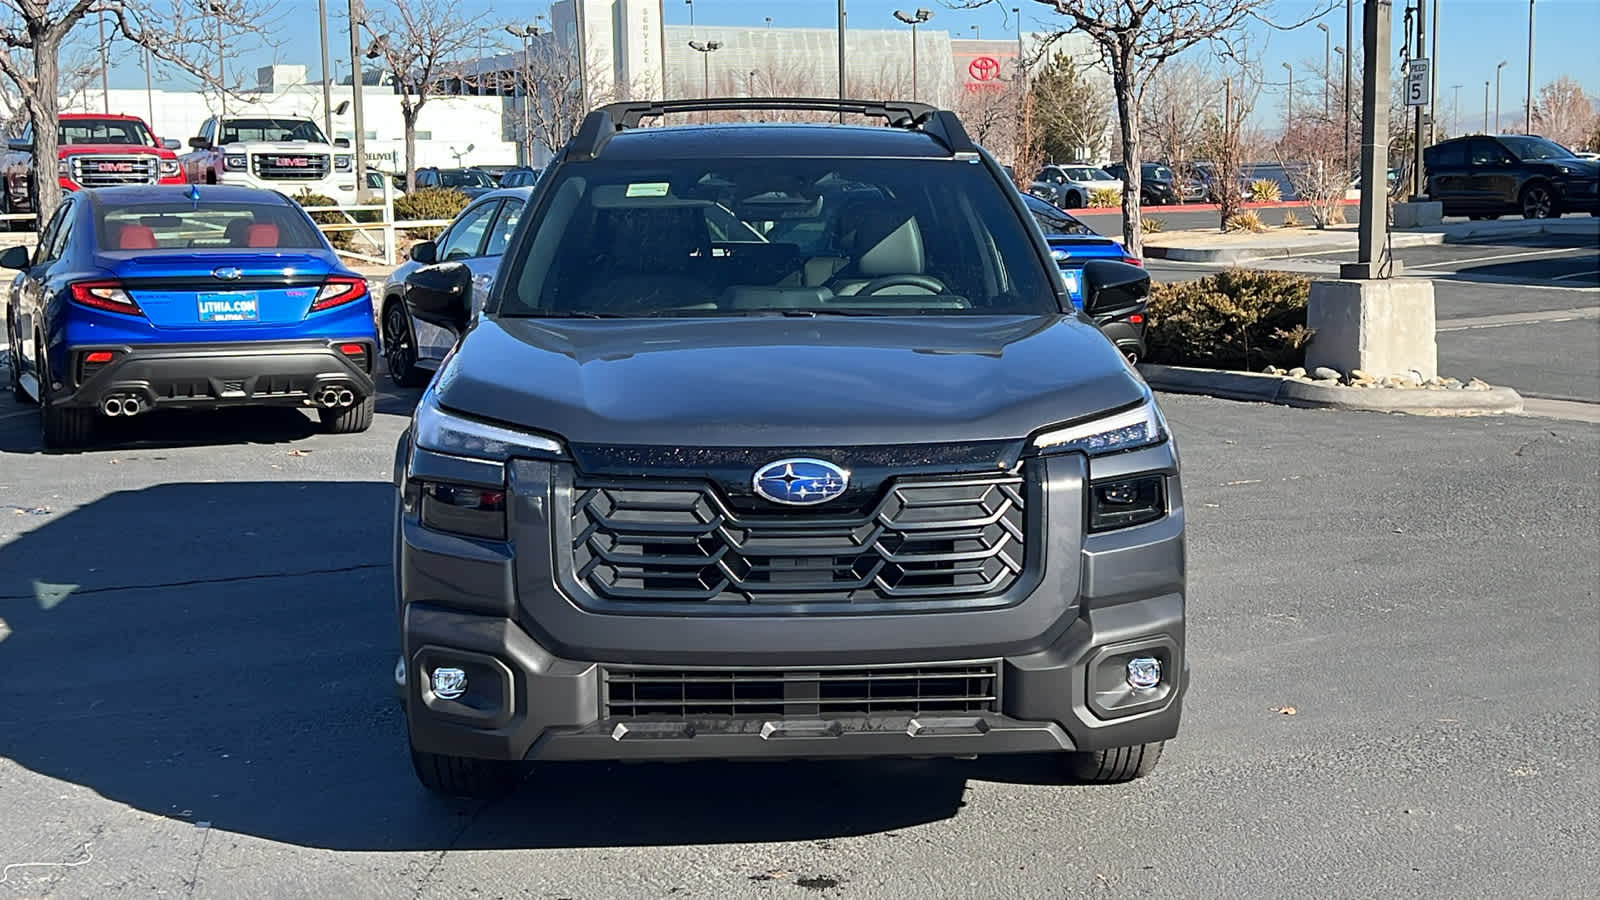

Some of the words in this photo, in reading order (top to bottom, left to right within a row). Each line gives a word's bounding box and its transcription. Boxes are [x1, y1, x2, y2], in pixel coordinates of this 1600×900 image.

[1408, 64, 1427, 72] PEED
[1411, 83, 1421, 99] 5
[275, 157, 308, 166] GMC
[98, 162, 133, 171] GMC
[199, 300, 256, 313] LITHIA.COM
